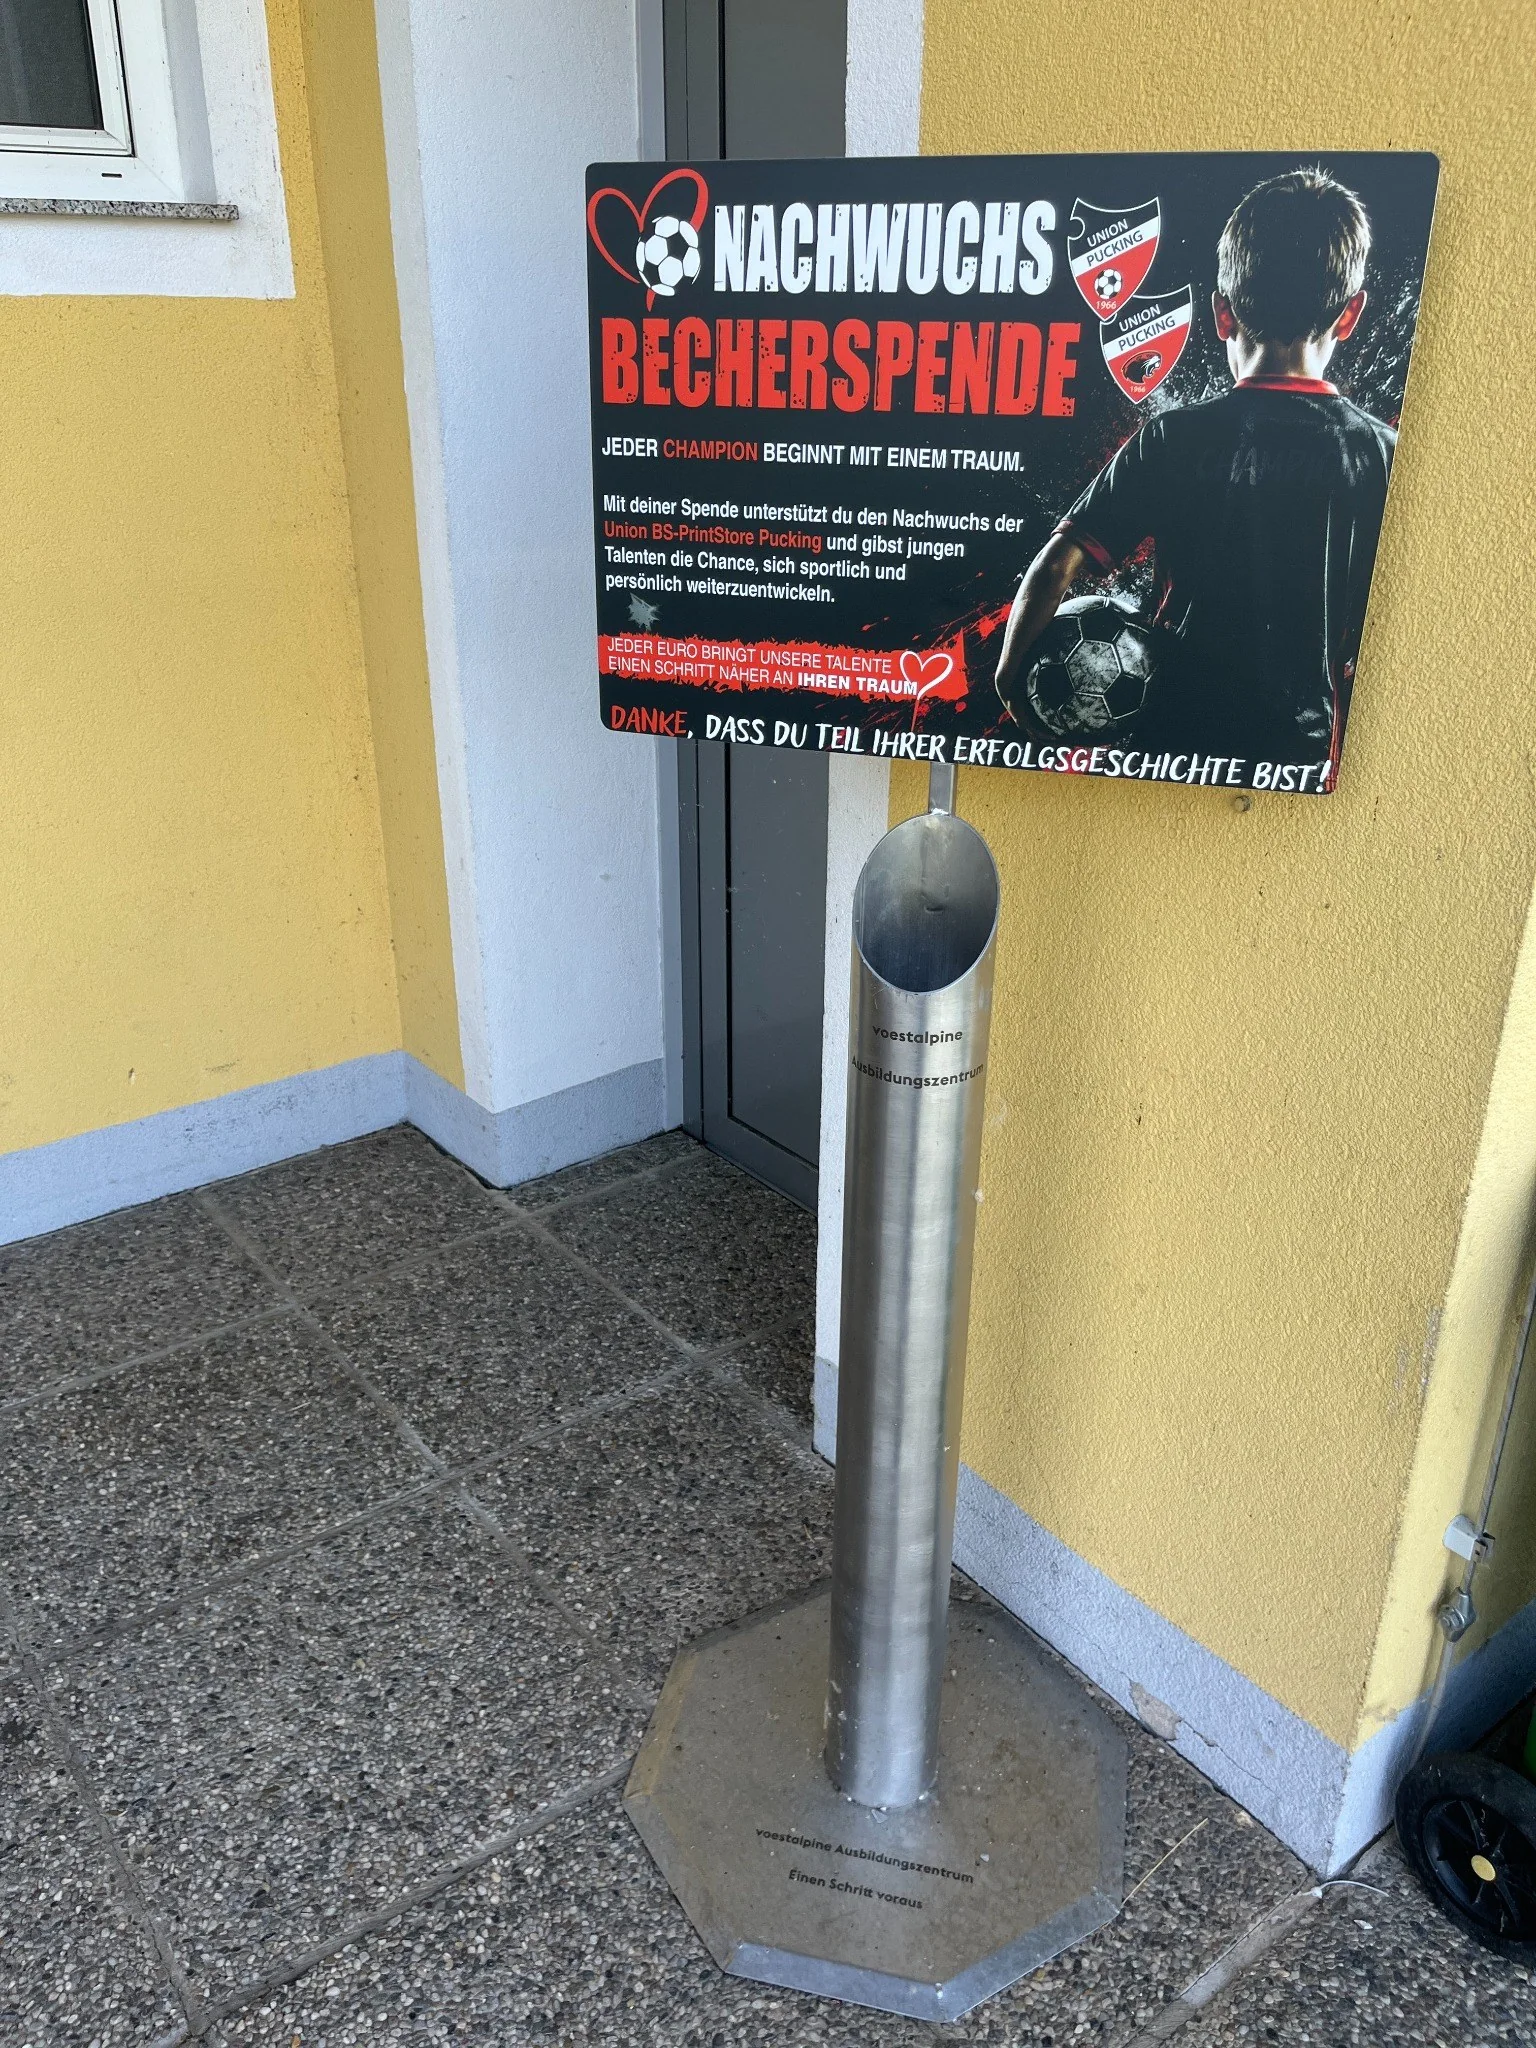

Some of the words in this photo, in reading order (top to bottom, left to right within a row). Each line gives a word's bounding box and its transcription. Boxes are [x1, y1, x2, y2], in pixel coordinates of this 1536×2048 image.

[713, 200, 1056, 296] NACHWUCHS
[1086, 218, 1129, 247] UNION
[1086, 230, 1143, 267] PUCKING
[1096, 301, 1117, 309] 1966
[1119, 304, 1161, 332] UNION
[1118, 315, 1176, 351] PUCKING
[601, 317, 1081, 418] BECHERSPENDE
[601, 436, 658, 457] JEDER
[662, 439, 758, 462] CHAMPION
[763, 442, 845, 464] BEGINNT
[849, 446, 882, 466] MIT
[887, 447, 946, 469] EINEM
[951, 449, 1025, 472] TRAUM.
[603, 495, 626, 513] Mit
[629, 496, 677, 516] deiner
[681, 499, 739, 522] Spende
[743, 502, 827, 523] unterstützt
[832, 506, 852, 525] du
[857, 507, 887, 527] den
[892, 508, 990, 531] Nachwuchs
[994, 512, 1024, 533] der
[604, 521, 647, 540] Union
[651, 523, 754, 546] BS-PrintStore
[759, 528, 822, 553] Pucking
[826, 532, 857, 551] und
[861, 534, 903, 556] gibst
[905, 536, 965, 560] jungen
[604, 546, 666, 566] Talenten
[670, 549, 693, 568] die
[697, 551, 759, 574] Chance,
[763, 555, 796, 574] sich
[799, 557, 871, 580] sportlich
[875, 561, 906, 580] und
[605, 571, 682, 594] persönlich
[686, 577, 835, 603] weiterzuentwickeln.
[607, 637, 653, 655] JEDER
[657, 640, 697, 658] EURO
[702, 643, 757, 663] BRINGT
[760, 649, 821, 669] UNSERE
[825, 654, 891, 674] TALENTE
[609, 656, 651, 672] EINEN
[654, 660, 715, 678] SCHRITT
[719, 663, 770, 682] NÄHER
[773, 670, 793, 685] AN
[798, 672, 850, 689] IHREN
[856, 676, 917, 695] TRAUM
[611, 705, 694, 739] DANKE,
[706, 714, 765, 744] DASS
[774, 720, 807, 747] DU
[815, 723, 864, 754] TEIL
[873, 729, 946, 763] IHRER
[954, 736, 1246, 785] ERFOLGSGESCHICHTE
[1252, 759, 1332, 792] BIST!
[873, 1026, 963, 1046] voestalpine
[852, 1056, 984, 1089] Ausbildungszentrum
[756, 1828, 832, 1851] voestalpine
[835, 1843, 974, 1884] Ausbildungszentrum
[788, 1869, 826, 1887] Einen
[829, 1878, 873, 1898] Schritt
[877, 1890, 923, 1909] voraus
